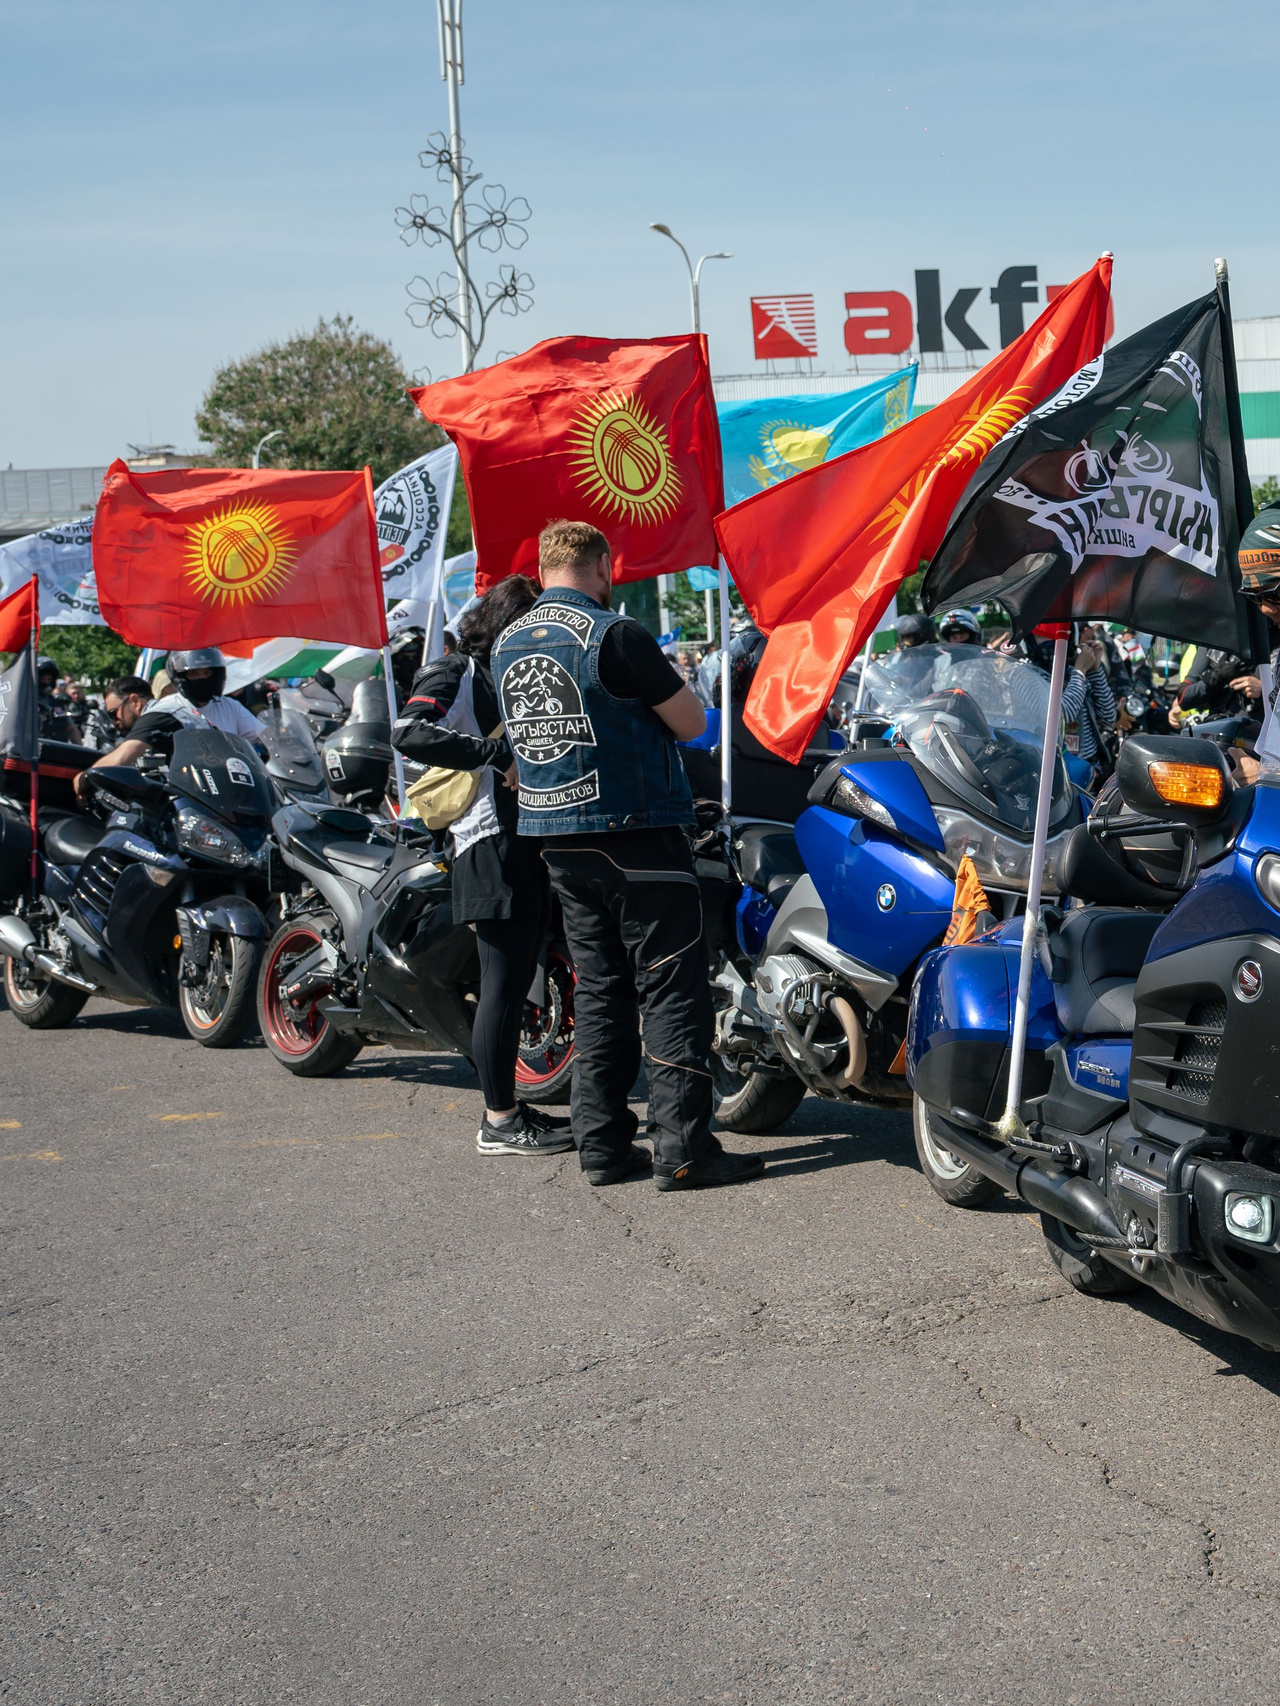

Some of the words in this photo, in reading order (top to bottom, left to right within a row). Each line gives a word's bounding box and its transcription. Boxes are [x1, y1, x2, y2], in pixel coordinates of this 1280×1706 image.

[844, 265, 1114, 354] akf
[505, 608, 588, 637] СООБЩЕСТВО
[508, 719, 589, 739] ЫРГЫЗСТАН
[526, 737, 555, 746] БИШКЕК
[519, 783, 594, 807] ОТОЦИКЛИСТОВ
